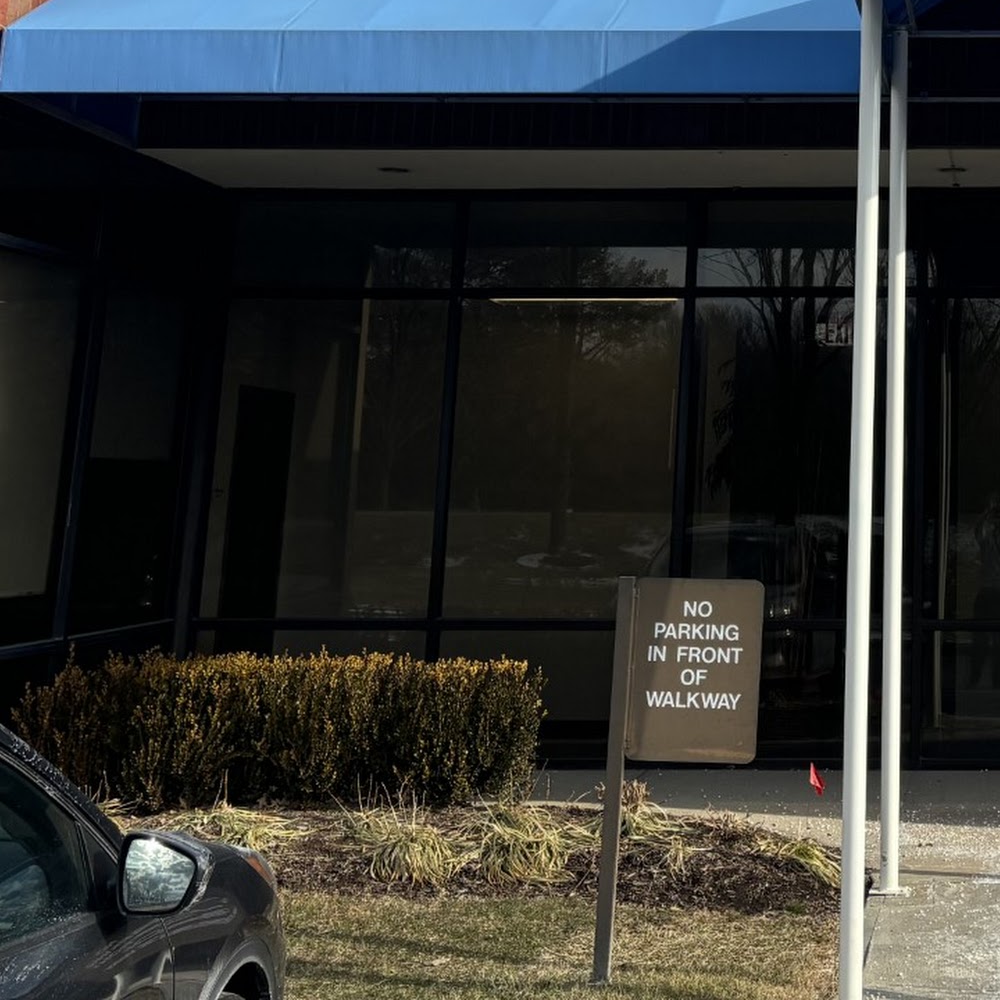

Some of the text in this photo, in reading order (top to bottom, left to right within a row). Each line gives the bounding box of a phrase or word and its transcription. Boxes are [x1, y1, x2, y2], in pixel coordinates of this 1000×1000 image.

[683, 600, 713, 618] NO
[654, 622, 740, 641] PARKING
[647, 645, 744, 664] IN FRONT
[680, 668, 708, 686] OF
[645, 690, 742, 710] WALKWAY
